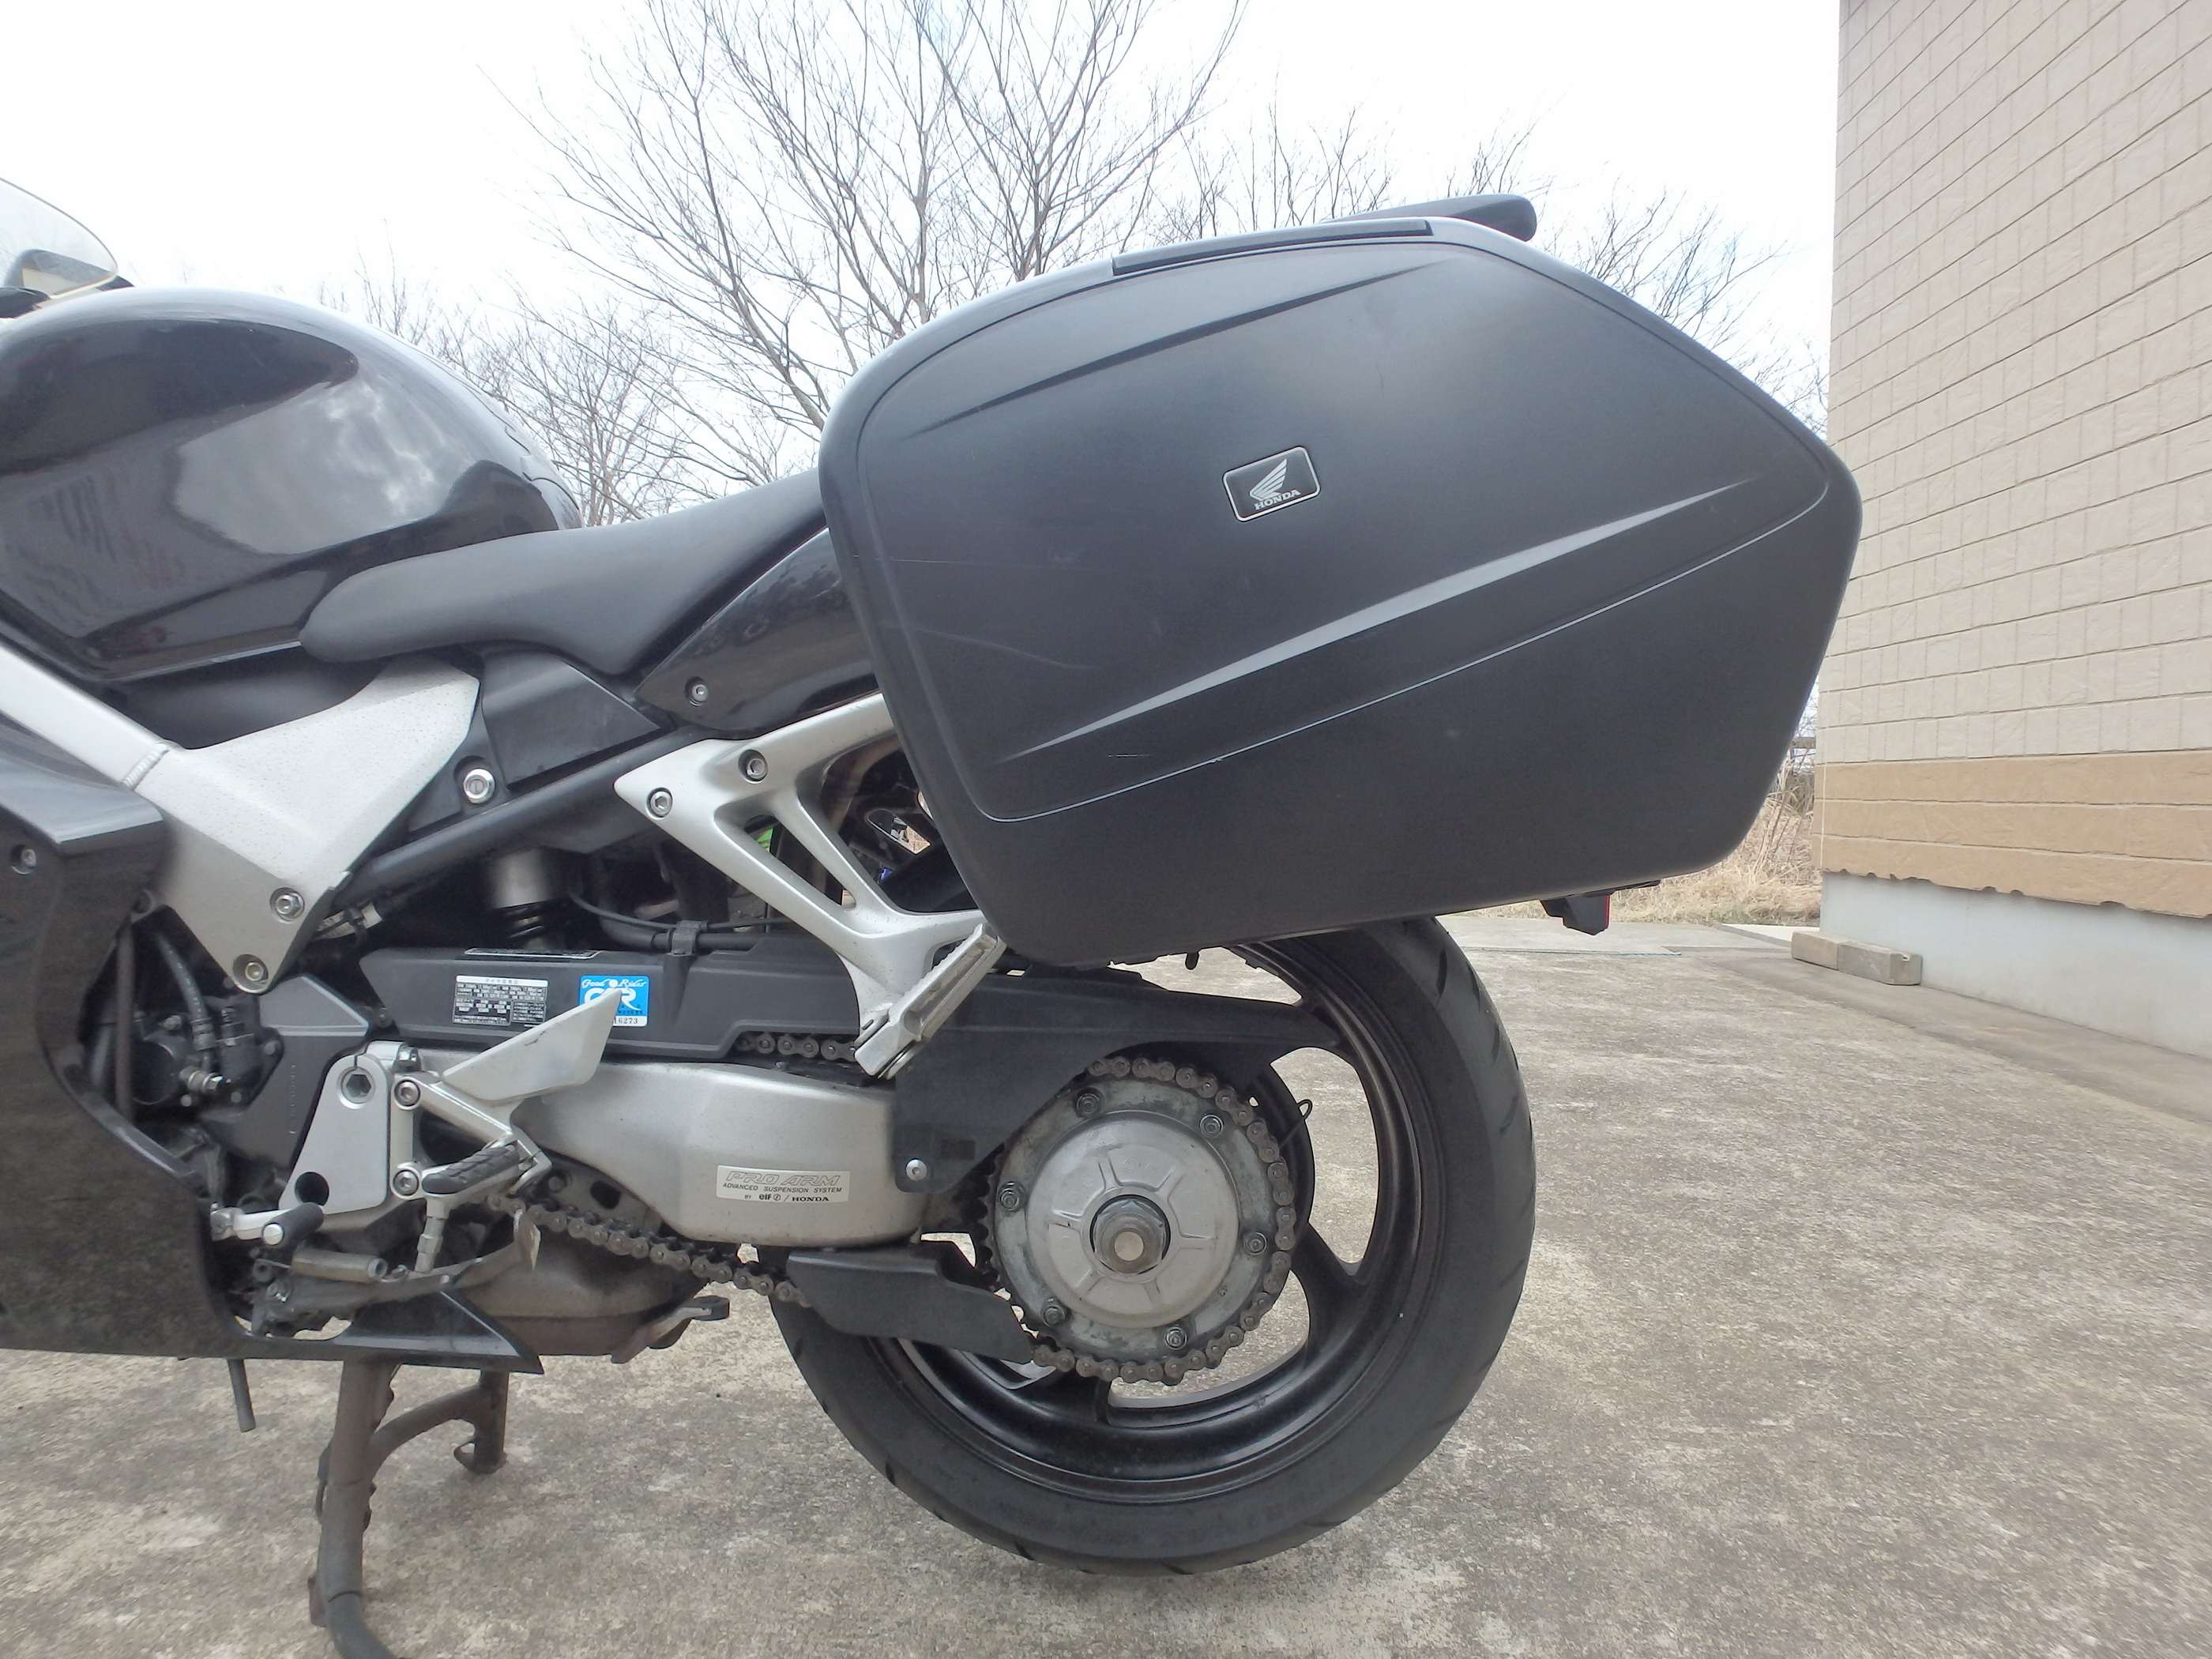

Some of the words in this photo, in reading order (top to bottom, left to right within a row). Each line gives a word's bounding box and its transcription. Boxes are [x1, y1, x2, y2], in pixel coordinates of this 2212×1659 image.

[1254, 489, 1301, 510] HONDA
[581, 979, 611, 988] Good
[618, 979, 647, 989] Rider
[726, 1171, 780, 1185] PRO
[781, 1175, 841, 1187] ARM
